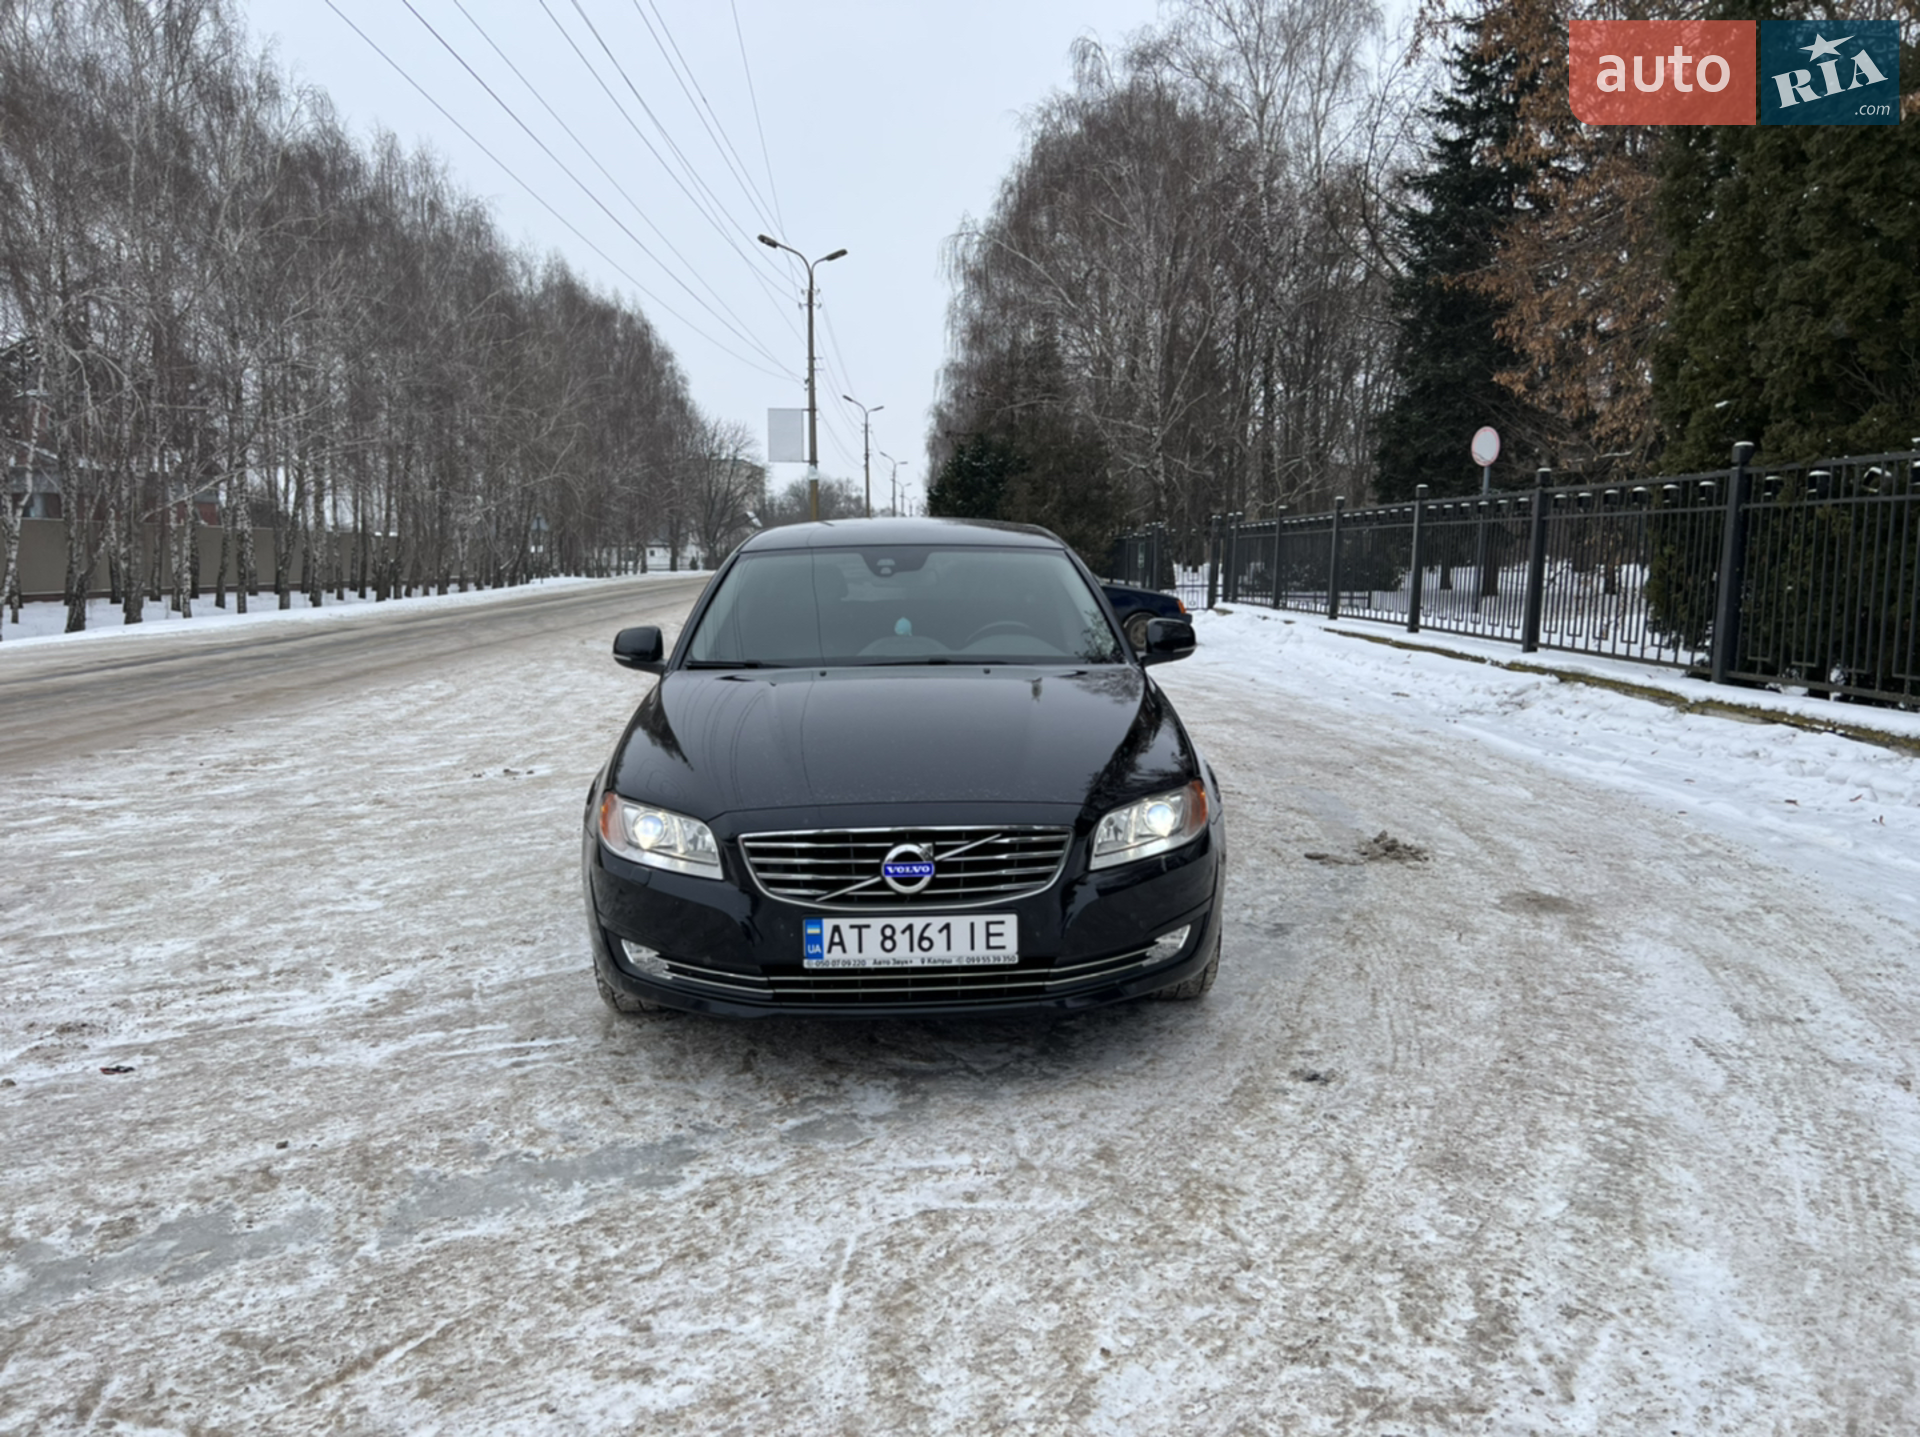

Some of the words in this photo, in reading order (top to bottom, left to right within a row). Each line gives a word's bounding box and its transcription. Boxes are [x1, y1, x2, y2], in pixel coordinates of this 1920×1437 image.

[886, 865, 931, 874] VOLVO
[827, 924, 871, 954] AT
[880, 922, 951, 953] 8161
[970, 920, 1007, 951] IE
[808, 944, 822, 954] UA
